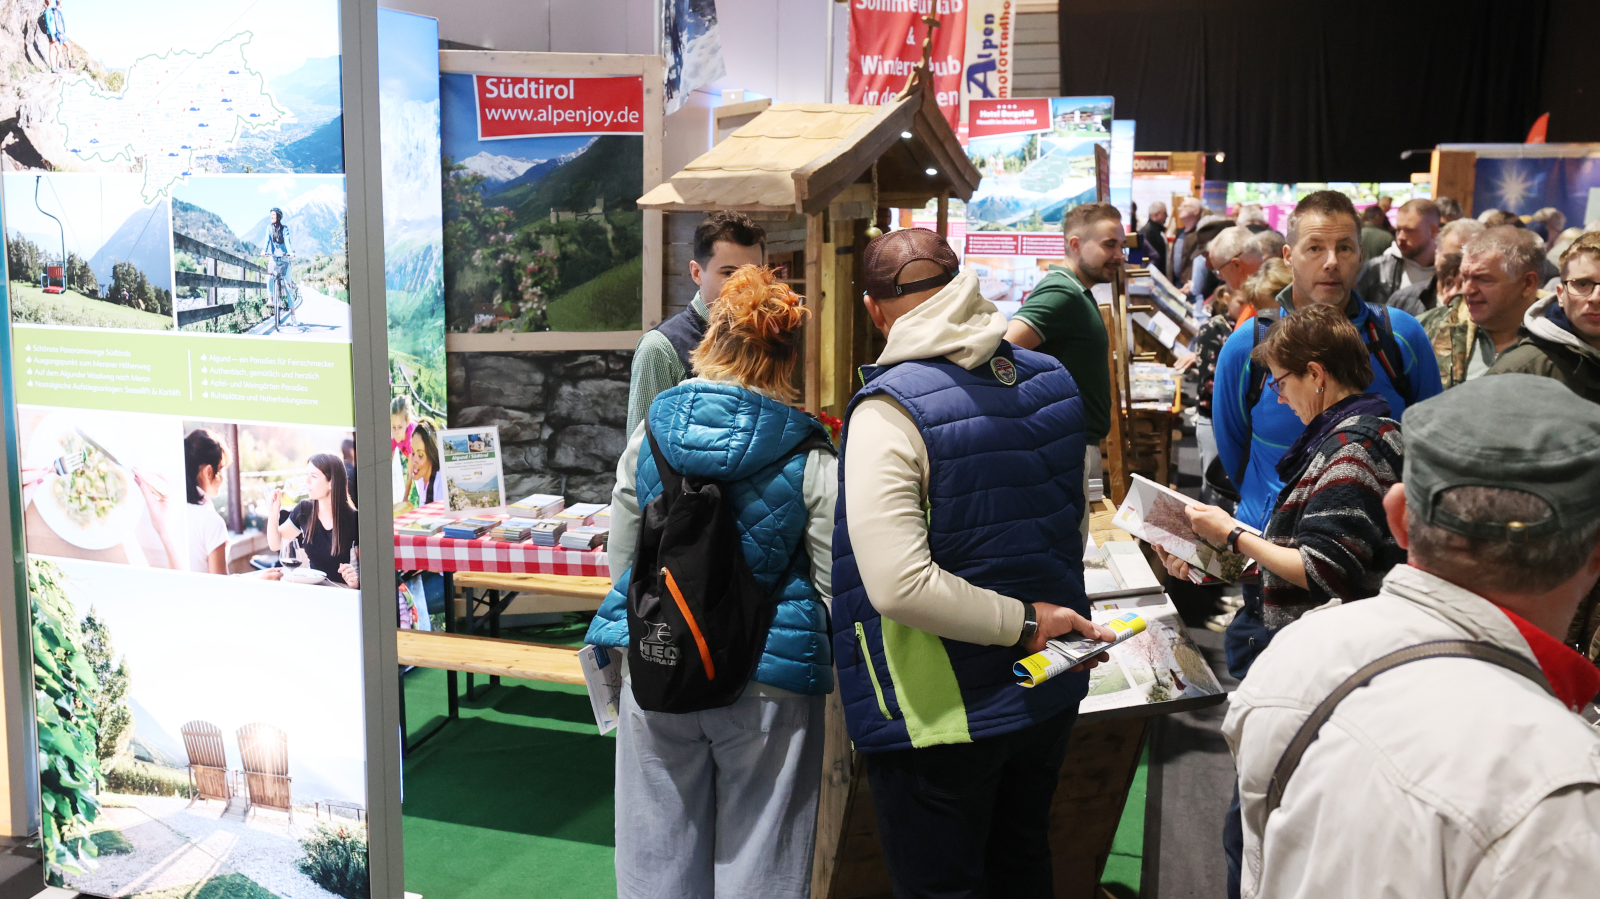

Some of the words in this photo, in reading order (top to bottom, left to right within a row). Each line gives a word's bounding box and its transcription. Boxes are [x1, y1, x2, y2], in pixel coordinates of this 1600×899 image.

[906, 26, 916, 45] &
[967, 13, 999, 98] Alpen
[485, 78, 575, 100] Südtirol
[862, 85, 879, 105] in
[485, 105, 639, 127] www.alpenjoy.de
[1133, 159, 1168, 170] ODUKTE
[32, 344, 59, 353] Schönste
[105, 349, 132, 357] Südtirols
[33, 356, 78, 367] Ausgangspunkt
[92, 359, 118, 369] Meraner
[118, 361, 151, 372] Höhenweg
[209, 354, 231, 363] Algund
[249, 356, 277, 365] Paradies
[277, 358, 287, 366] für
[287, 358, 335, 368] Feinschmecker
[34, 368, 45, 376] Auf
[45, 369, 59, 377] dem
[59, 370, 86, 380] Algunder
[115, 373, 130, 381] nach
[209, 367, 249, 377] Authentisch,
[249, 369, 281, 378] gemütlich
[294, 372, 320, 380] herzlich
[35, 380, 72, 391] Nostalgische
[158, 388, 182, 397] Korblift
[209, 379, 229, 388] Apfel-
[243, 382, 280, 391] Weingärten
[281, 383, 308, 392] Paradies
[210, 391, 245, 400] Ruheplätze
[246, 393, 259, 401] und
[259, 394, 319, 405] Naherholungszone
